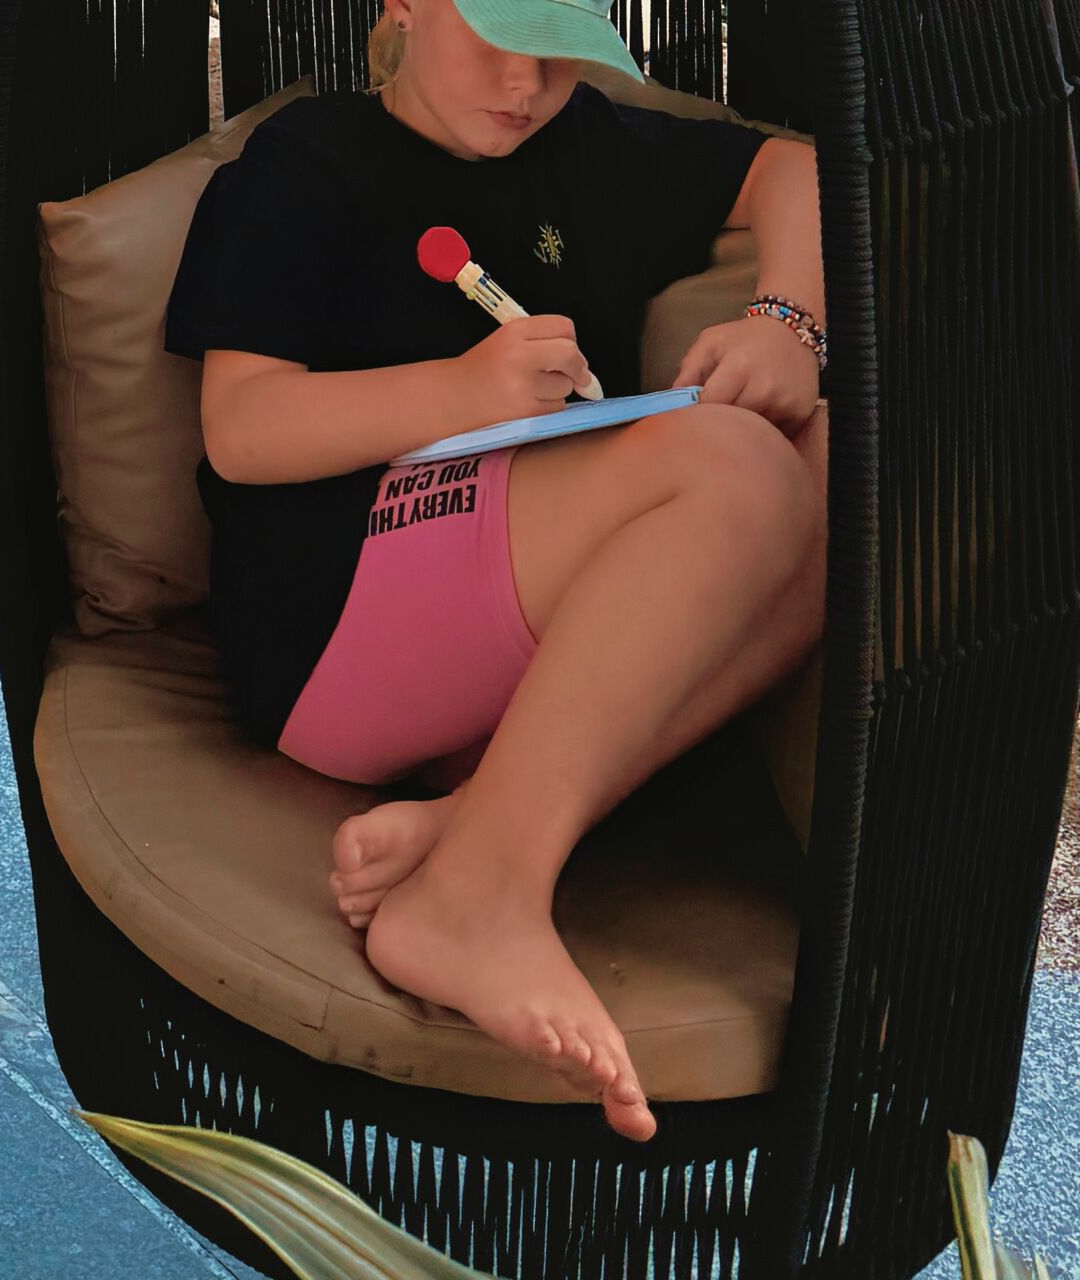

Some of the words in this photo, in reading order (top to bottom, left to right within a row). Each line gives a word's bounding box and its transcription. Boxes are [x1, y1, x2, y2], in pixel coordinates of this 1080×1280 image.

[384, 469, 435, 501] CAN
[437, 457, 482, 486] YOU
[369, 484, 477, 536] EVERYTHI
